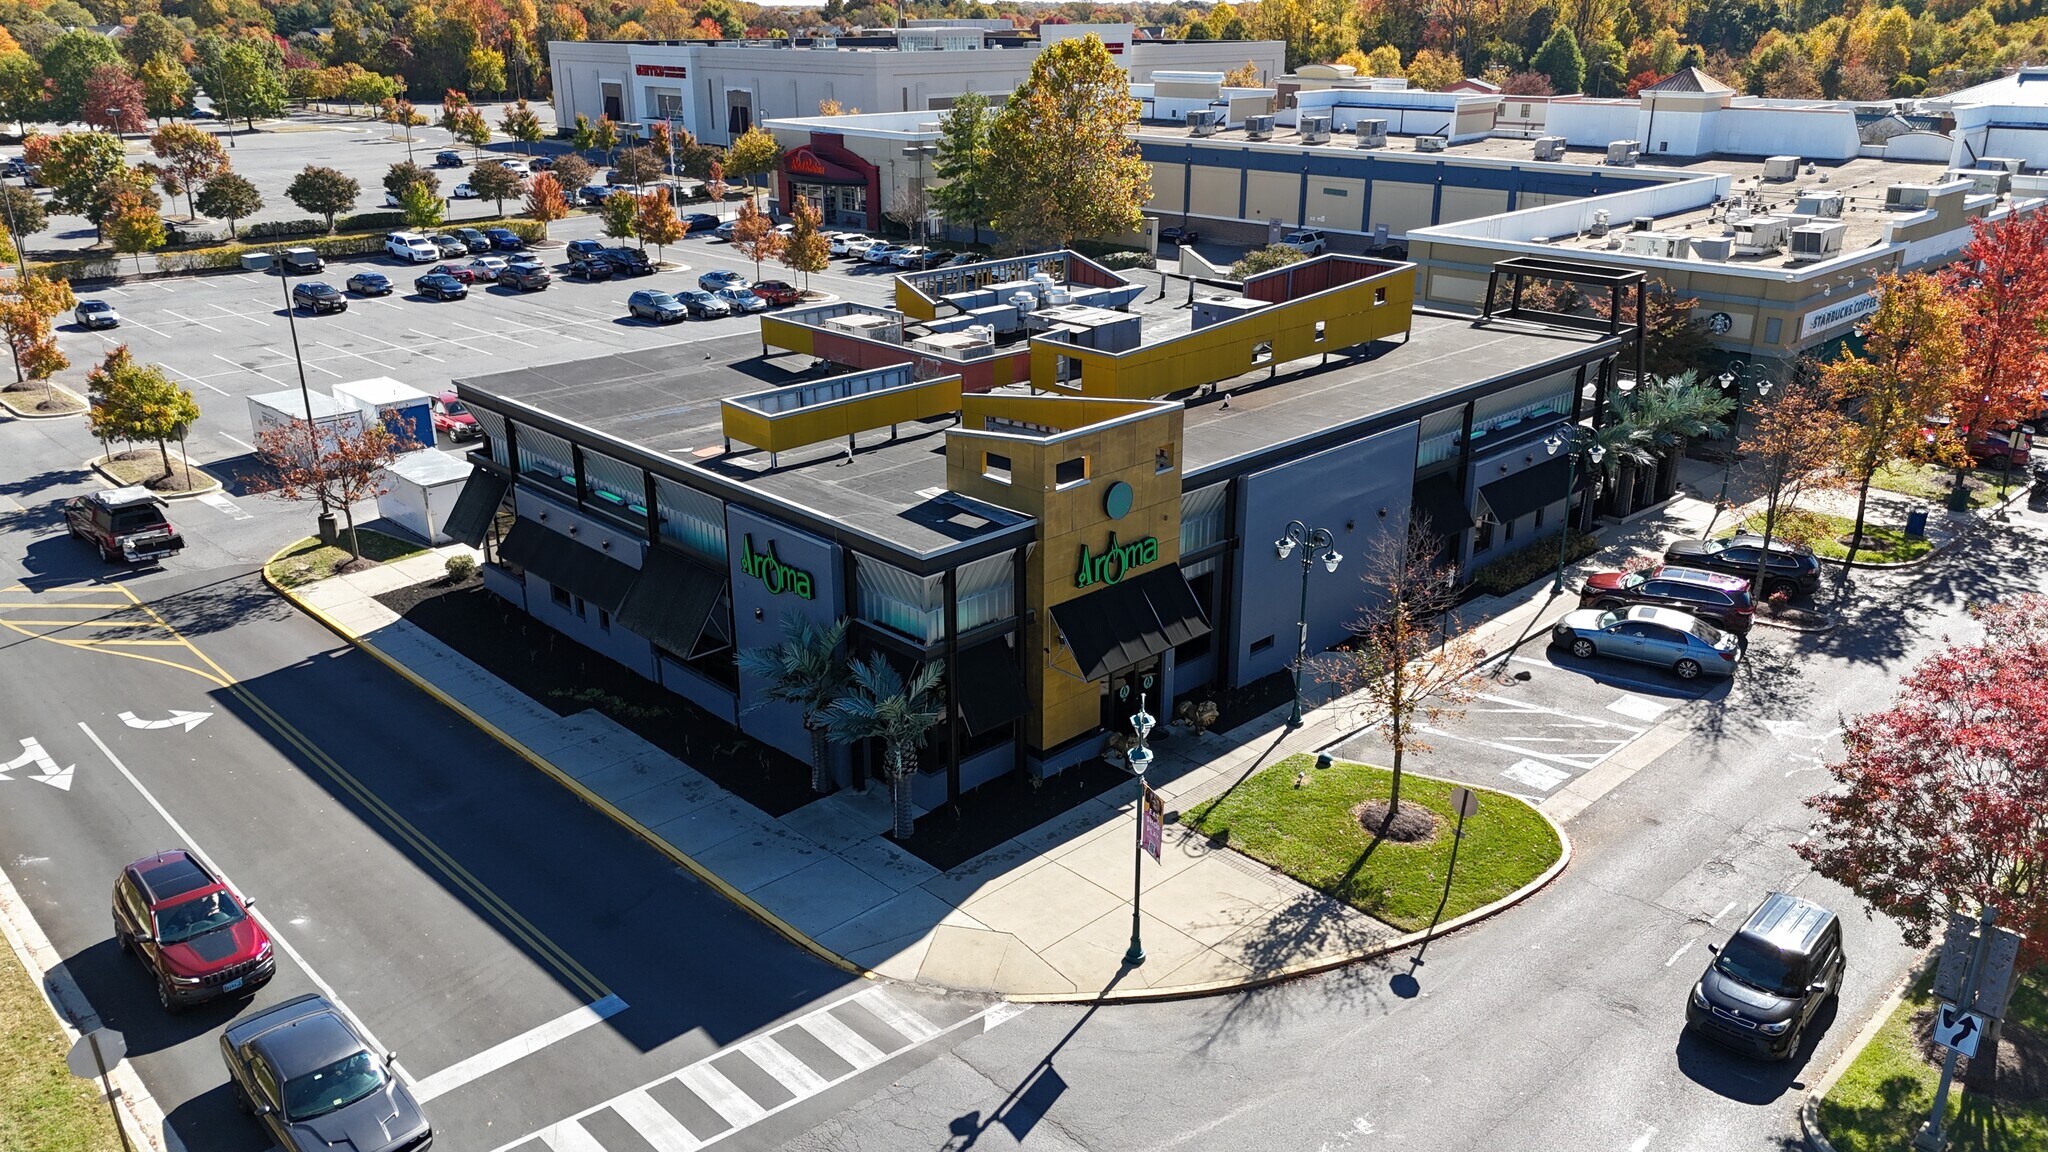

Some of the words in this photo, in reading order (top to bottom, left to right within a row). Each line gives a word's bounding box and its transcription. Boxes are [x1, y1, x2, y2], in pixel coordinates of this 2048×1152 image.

[1812, 304, 1853, 328] STARBUCKS
[1854, 297, 1877, 313] COFFEE
[1146, 815, 1160, 831] SHOP
[1146, 825, 1160, 840] PLAY
